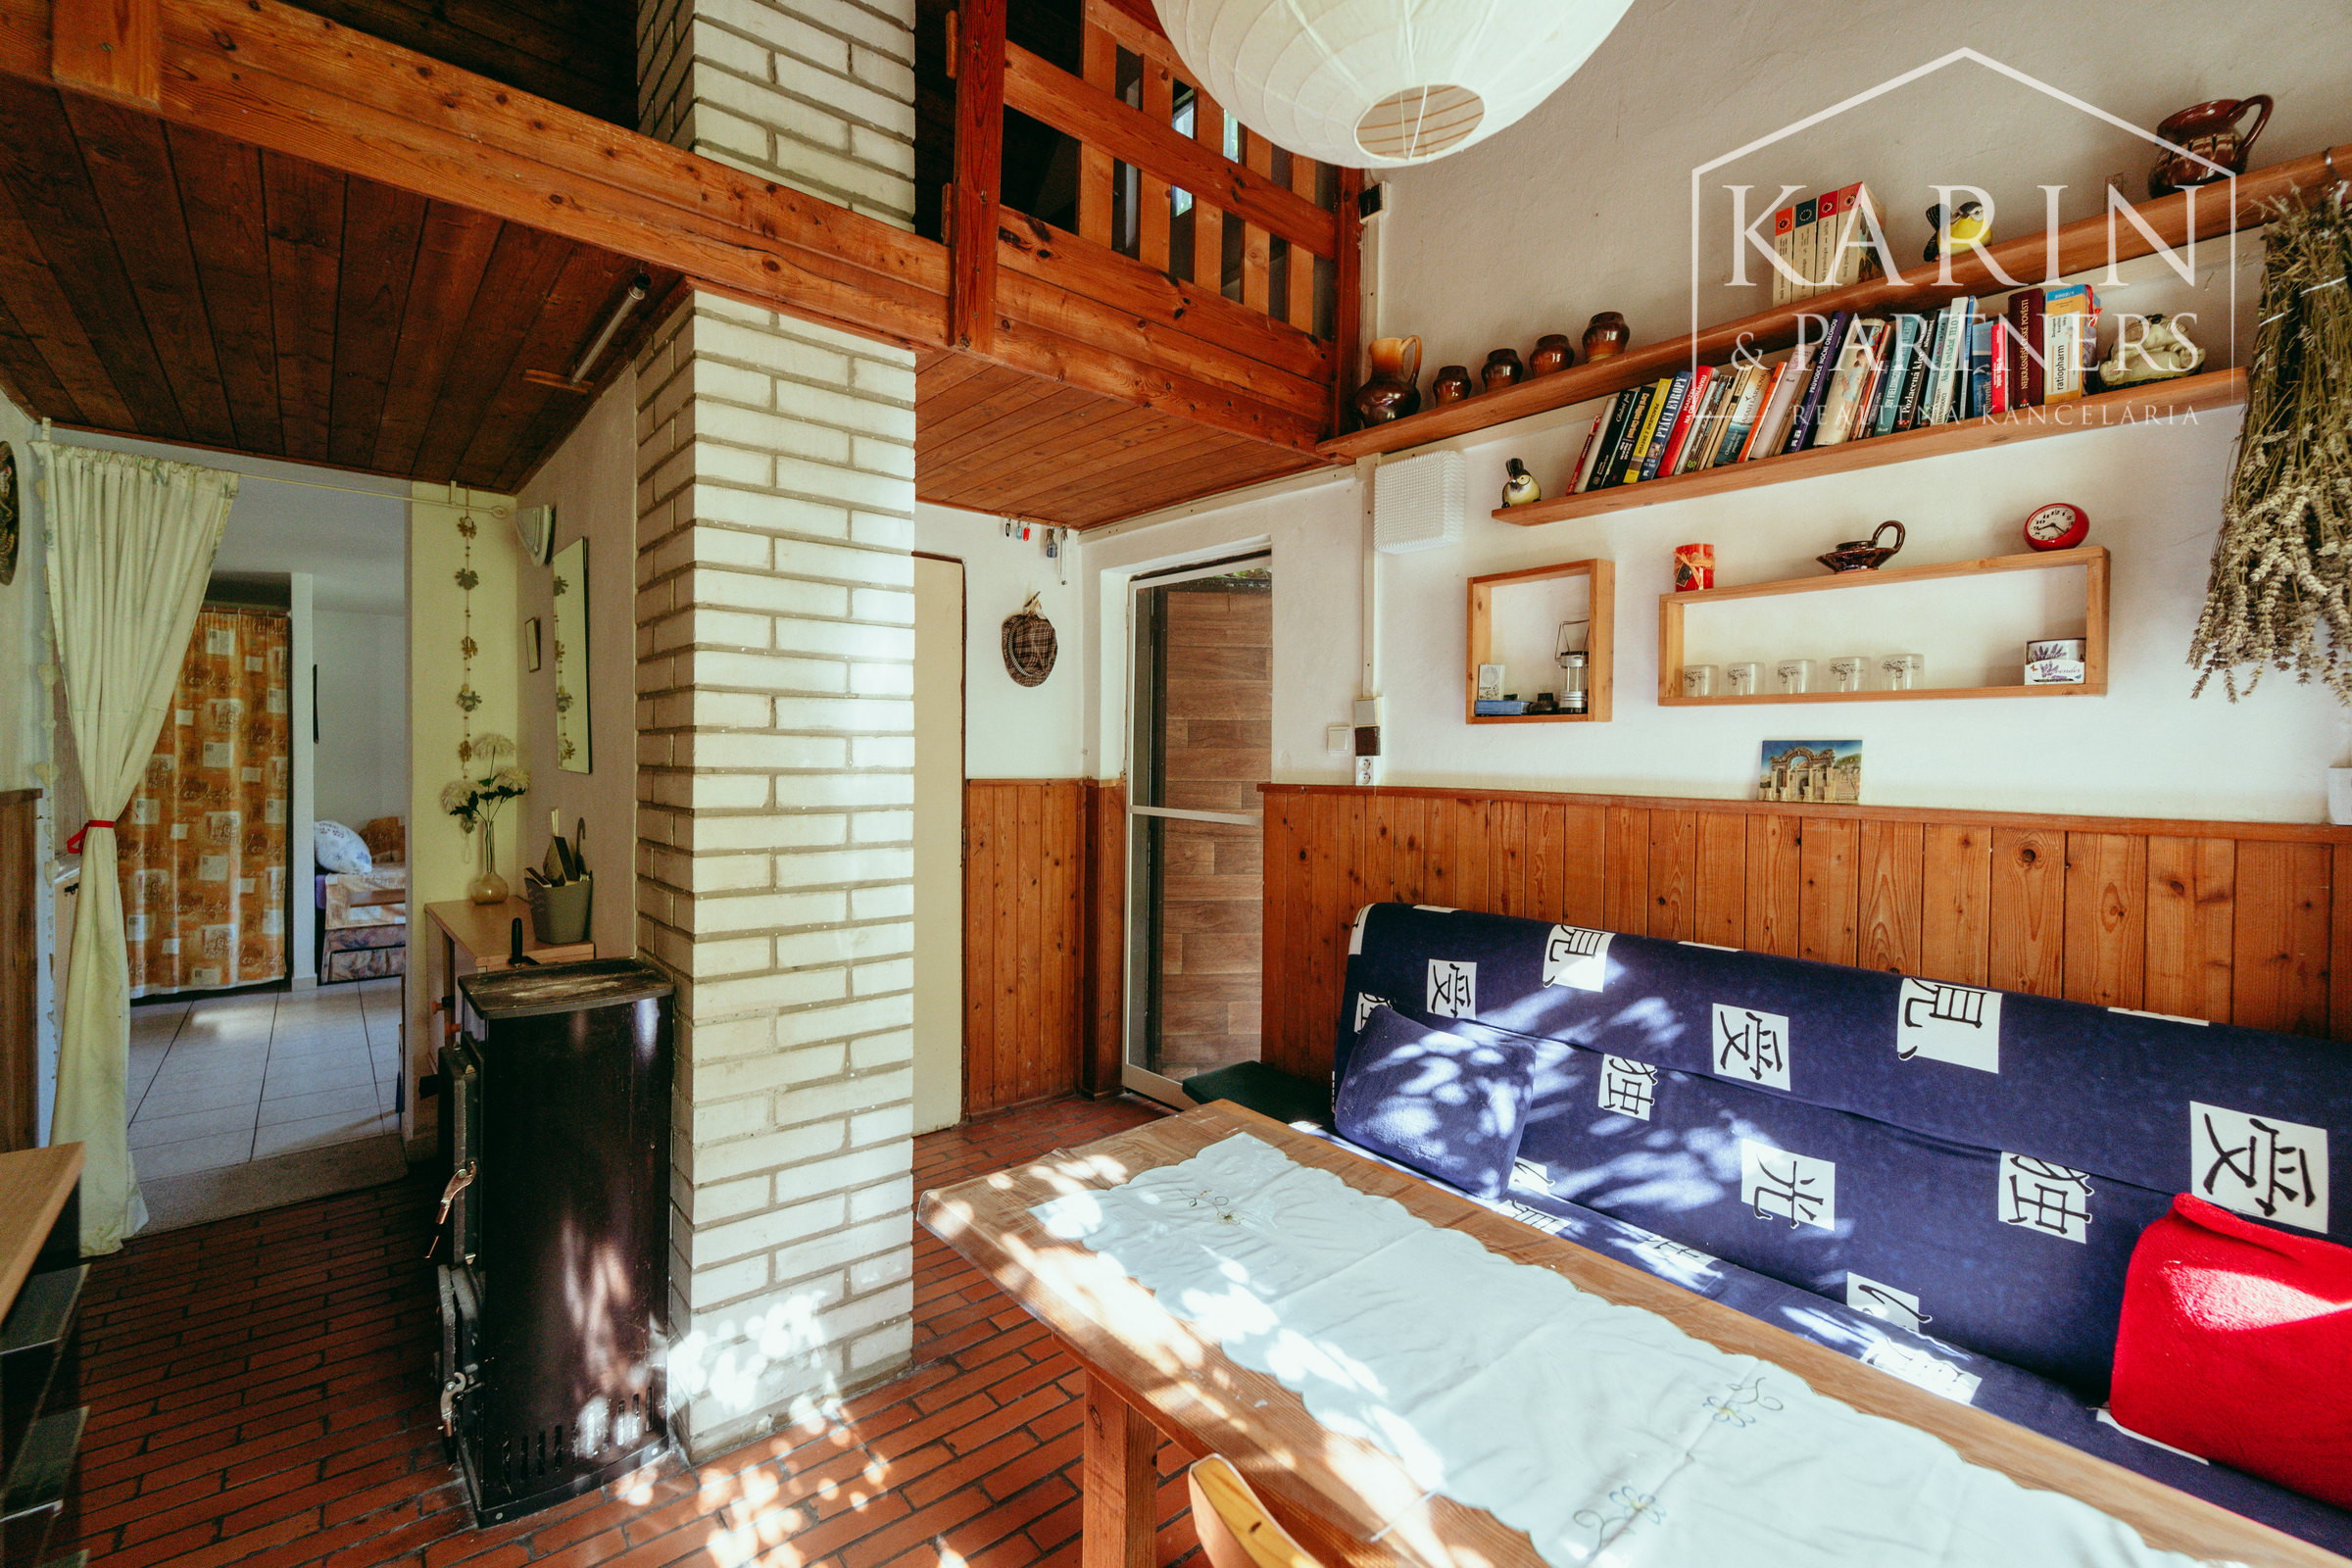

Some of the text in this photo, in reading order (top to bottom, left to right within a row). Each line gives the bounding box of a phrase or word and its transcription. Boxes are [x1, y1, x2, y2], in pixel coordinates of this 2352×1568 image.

[1808, 364, 1823, 393] PRŮVODCE
[1817, 345, 1829, 364] NOČNÍ
[1900, 349, 1925, 414] Pozlacená klec
[2054, 344, 2065, 389] ratiopharm
[1654, 410, 1674, 439] PTÁCI
[1666, 374, 1687, 411] EVROPY
[1431, 962, 1472, 1019] 受
[1722, 1010, 1783, 1081] 受
[1754, 1142, 1825, 1230] 光
[2202, 1112, 2316, 1217] 受
